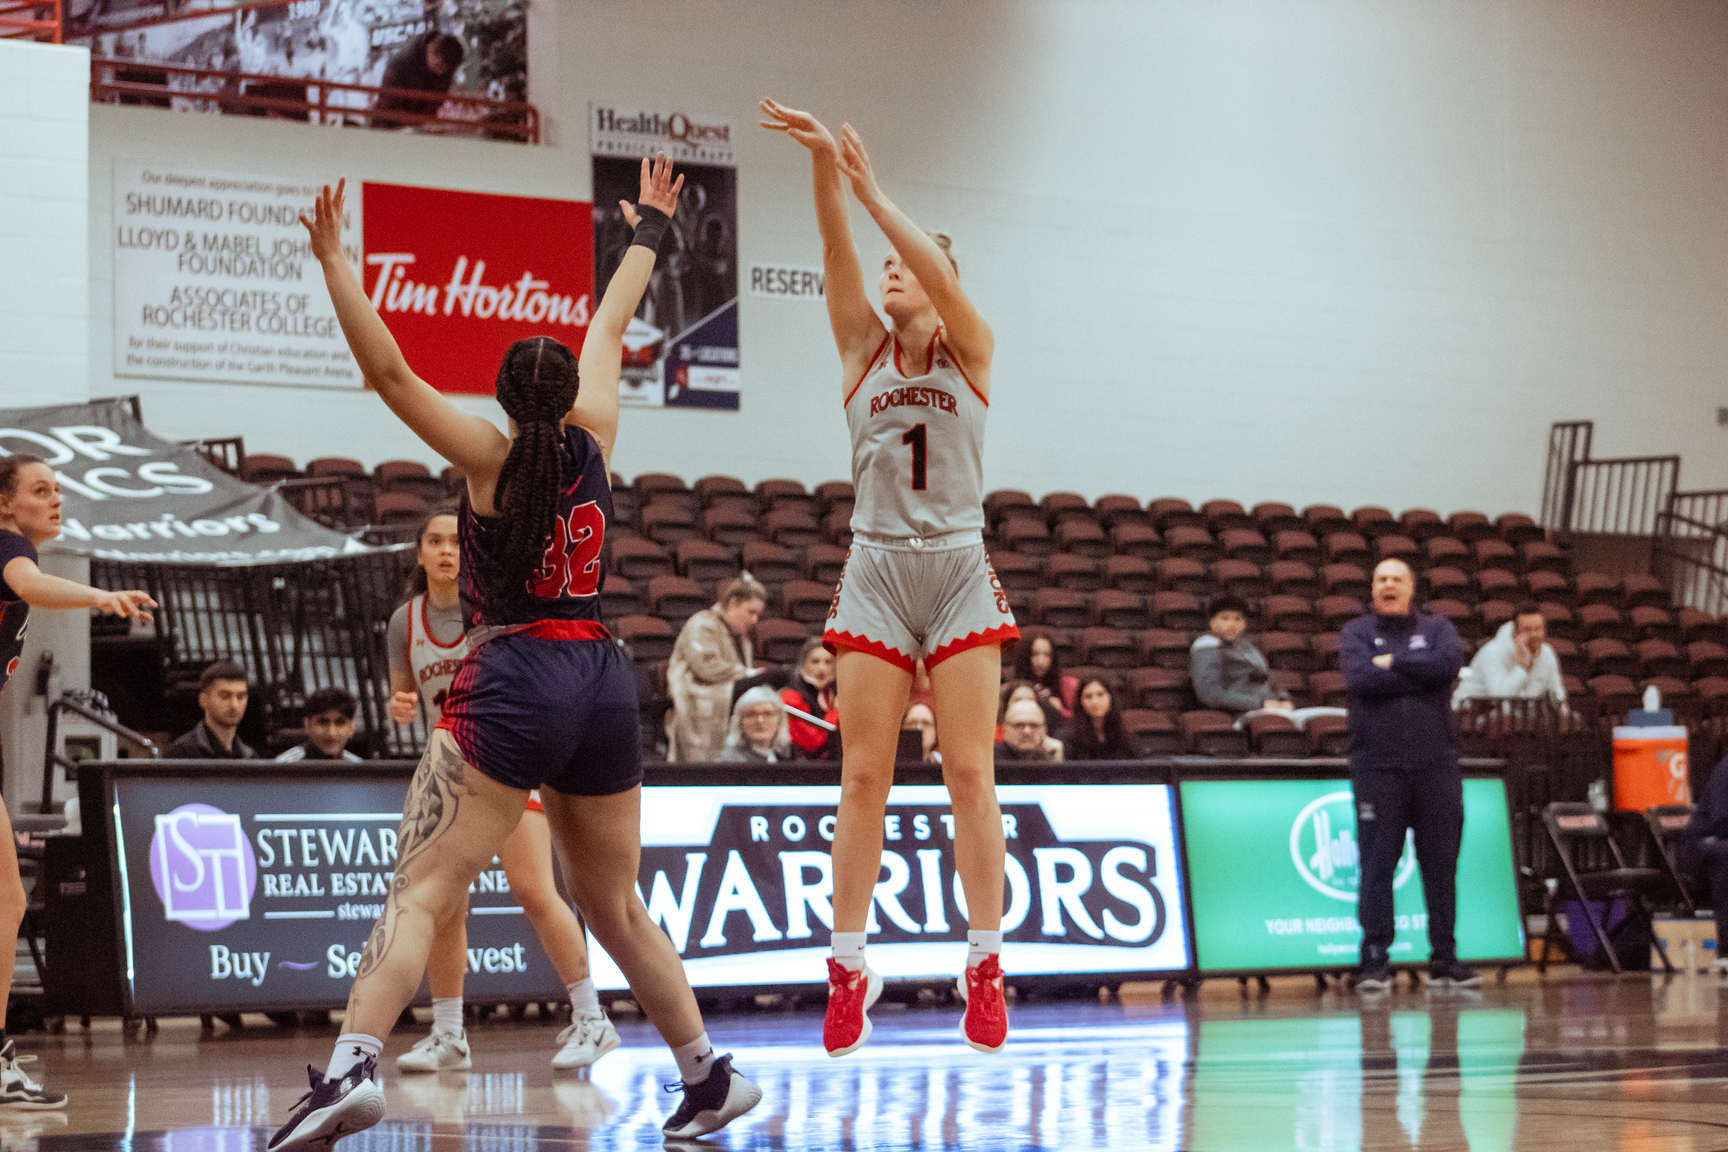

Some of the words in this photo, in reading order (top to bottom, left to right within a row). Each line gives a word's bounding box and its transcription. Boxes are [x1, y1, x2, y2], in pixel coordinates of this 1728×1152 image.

[597, 107, 730, 149] HealthQuest
[126, 192, 223, 221] SHUMARD
[228, 200, 351, 230] FOUNDN
[118, 226, 179, 250] LLOYD
[183, 231, 197, 251] &
[203, 233, 259, 258] MABEL
[271, 238, 359, 263] JOHN
[178, 252, 302, 281] FOUNDATION
[751, 266, 825, 296] RESERV
[170, 285, 281, 313] ASSOCIATES
[286, 293, 310, 315] OF
[366, 253, 438, 316] Tim
[444, 255, 589, 327] Hortons
[142, 304, 251, 332] ROCHESTER
[256, 312, 338, 339] COLLEGE
[869, 386, 959, 418] ROCHESTER
[902, 423, 927, 491] 1
[749, 813, 1019, 842] ROCESTR
[257, 826, 398, 867] STEWAR
[263, 873, 325, 897] REAL
[330, 872, 394, 897] ESTA
[634, 846, 1159, 954] WARRIORS
[1265, 919, 1304, 935] YOUR
[210, 944, 271, 987] Buy
[326, 943, 367, 979] Se
[466, 942, 528, 975] vest
